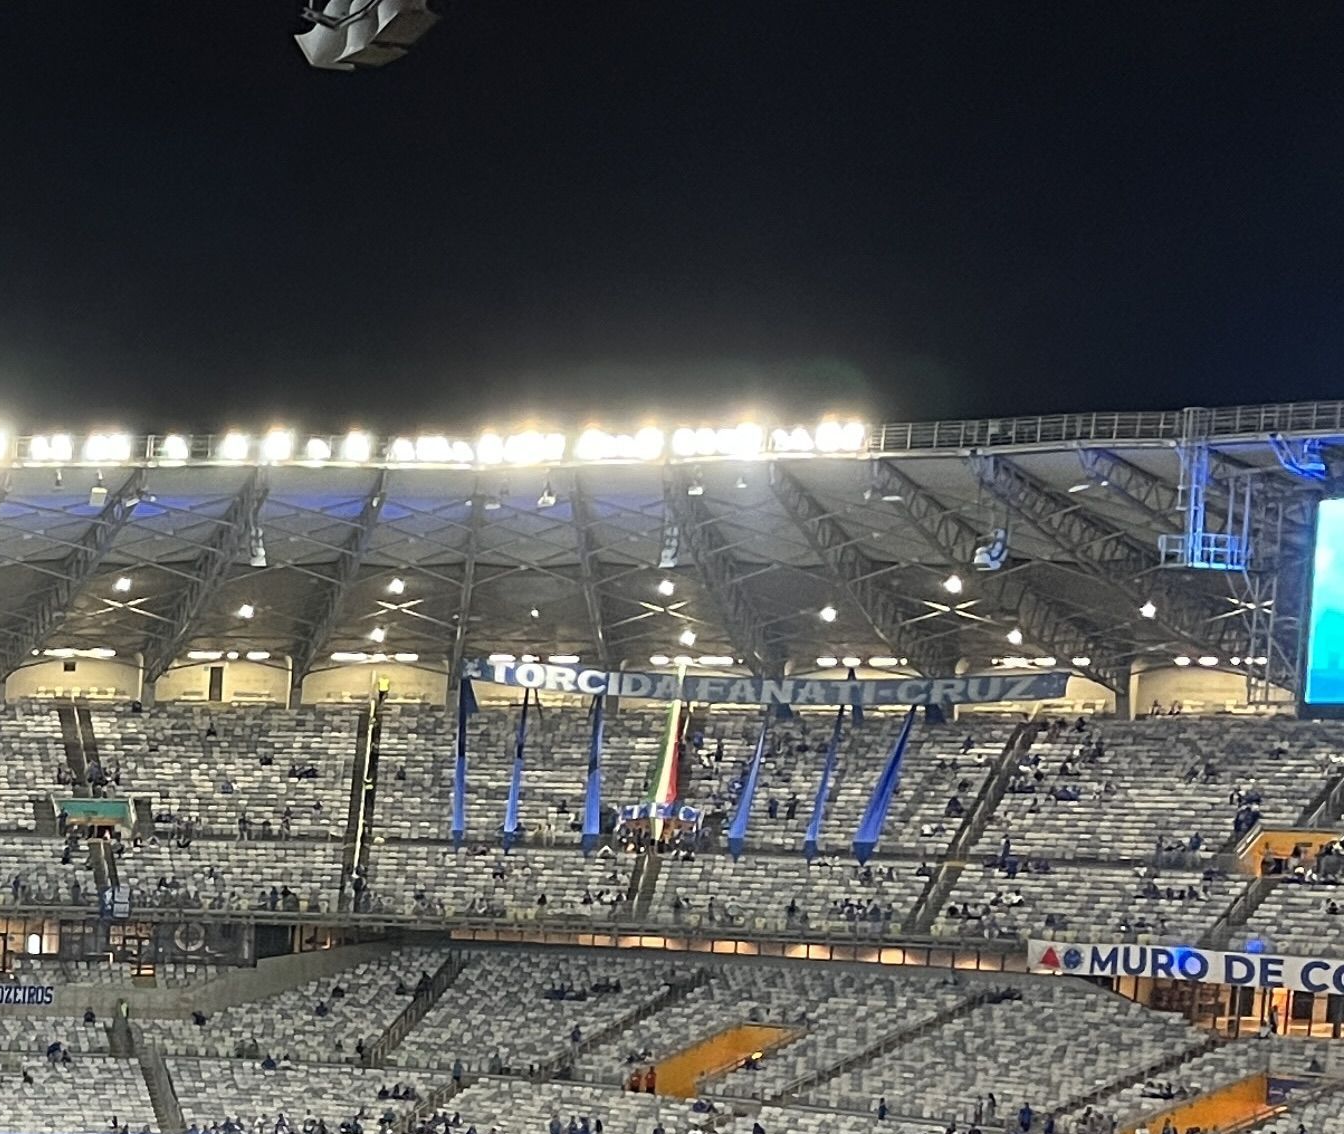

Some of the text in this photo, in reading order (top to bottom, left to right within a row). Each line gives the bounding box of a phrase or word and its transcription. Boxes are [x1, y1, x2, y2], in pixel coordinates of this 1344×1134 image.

[487, 656, 679, 697] TORCIDA
[1089, 946, 1209, 982] MURO
[1224, 954, 1284, 987] DE
